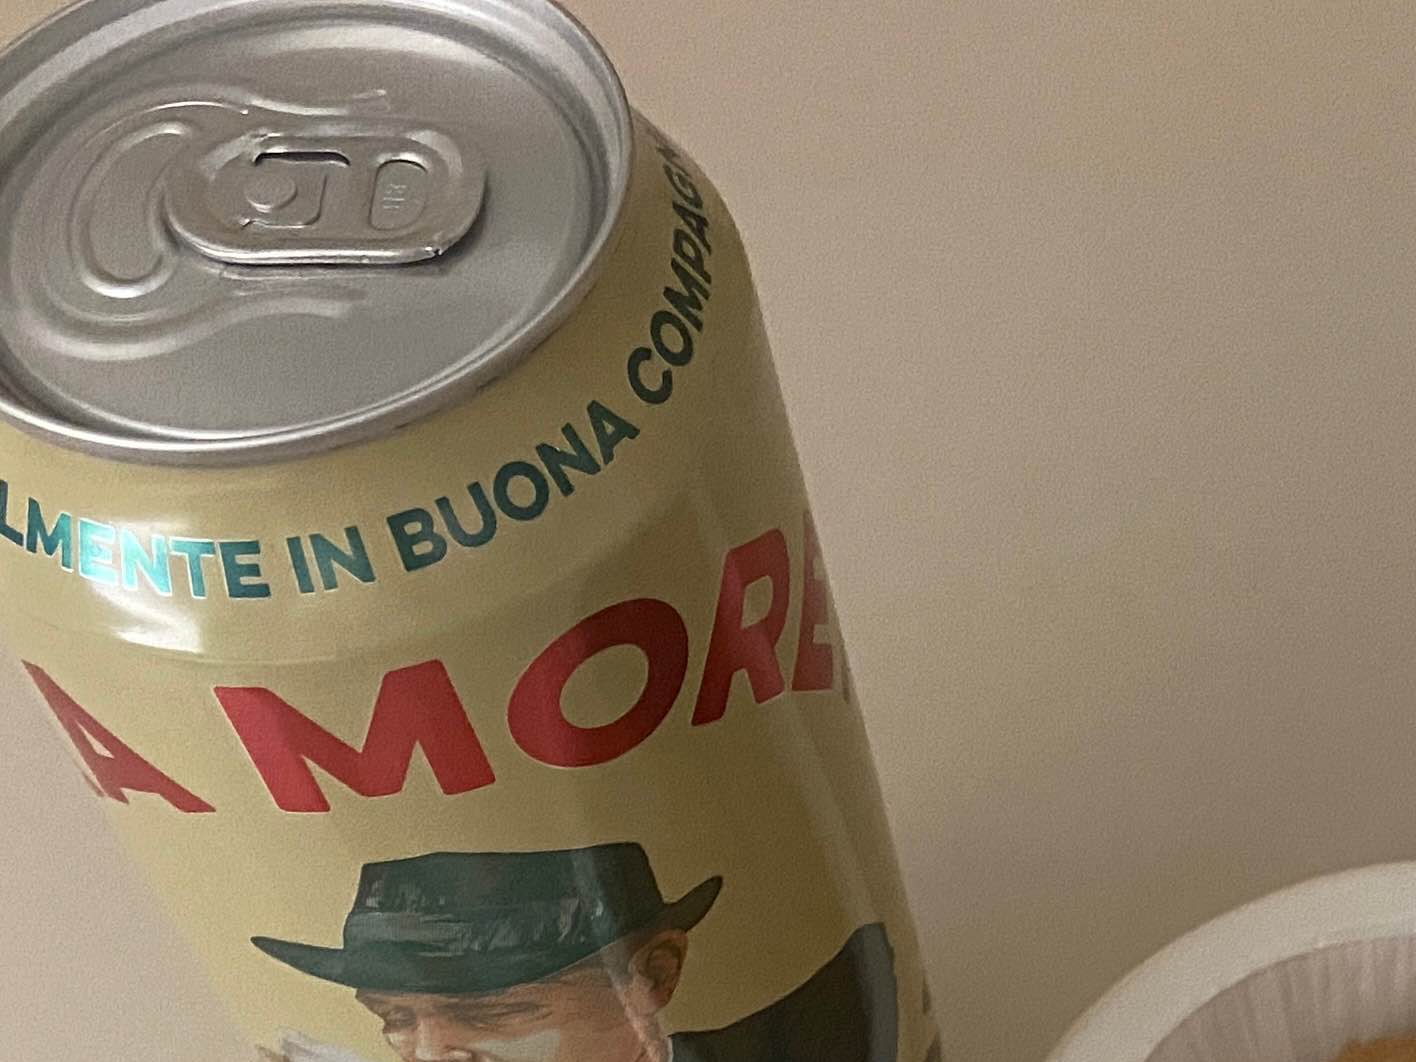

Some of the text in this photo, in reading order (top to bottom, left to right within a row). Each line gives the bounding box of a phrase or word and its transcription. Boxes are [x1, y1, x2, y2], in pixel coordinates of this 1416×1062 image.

[287, 525, 376, 595] IN
[386, 400, 640, 572] BUONA
[213, 511, 852, 813] MORE
